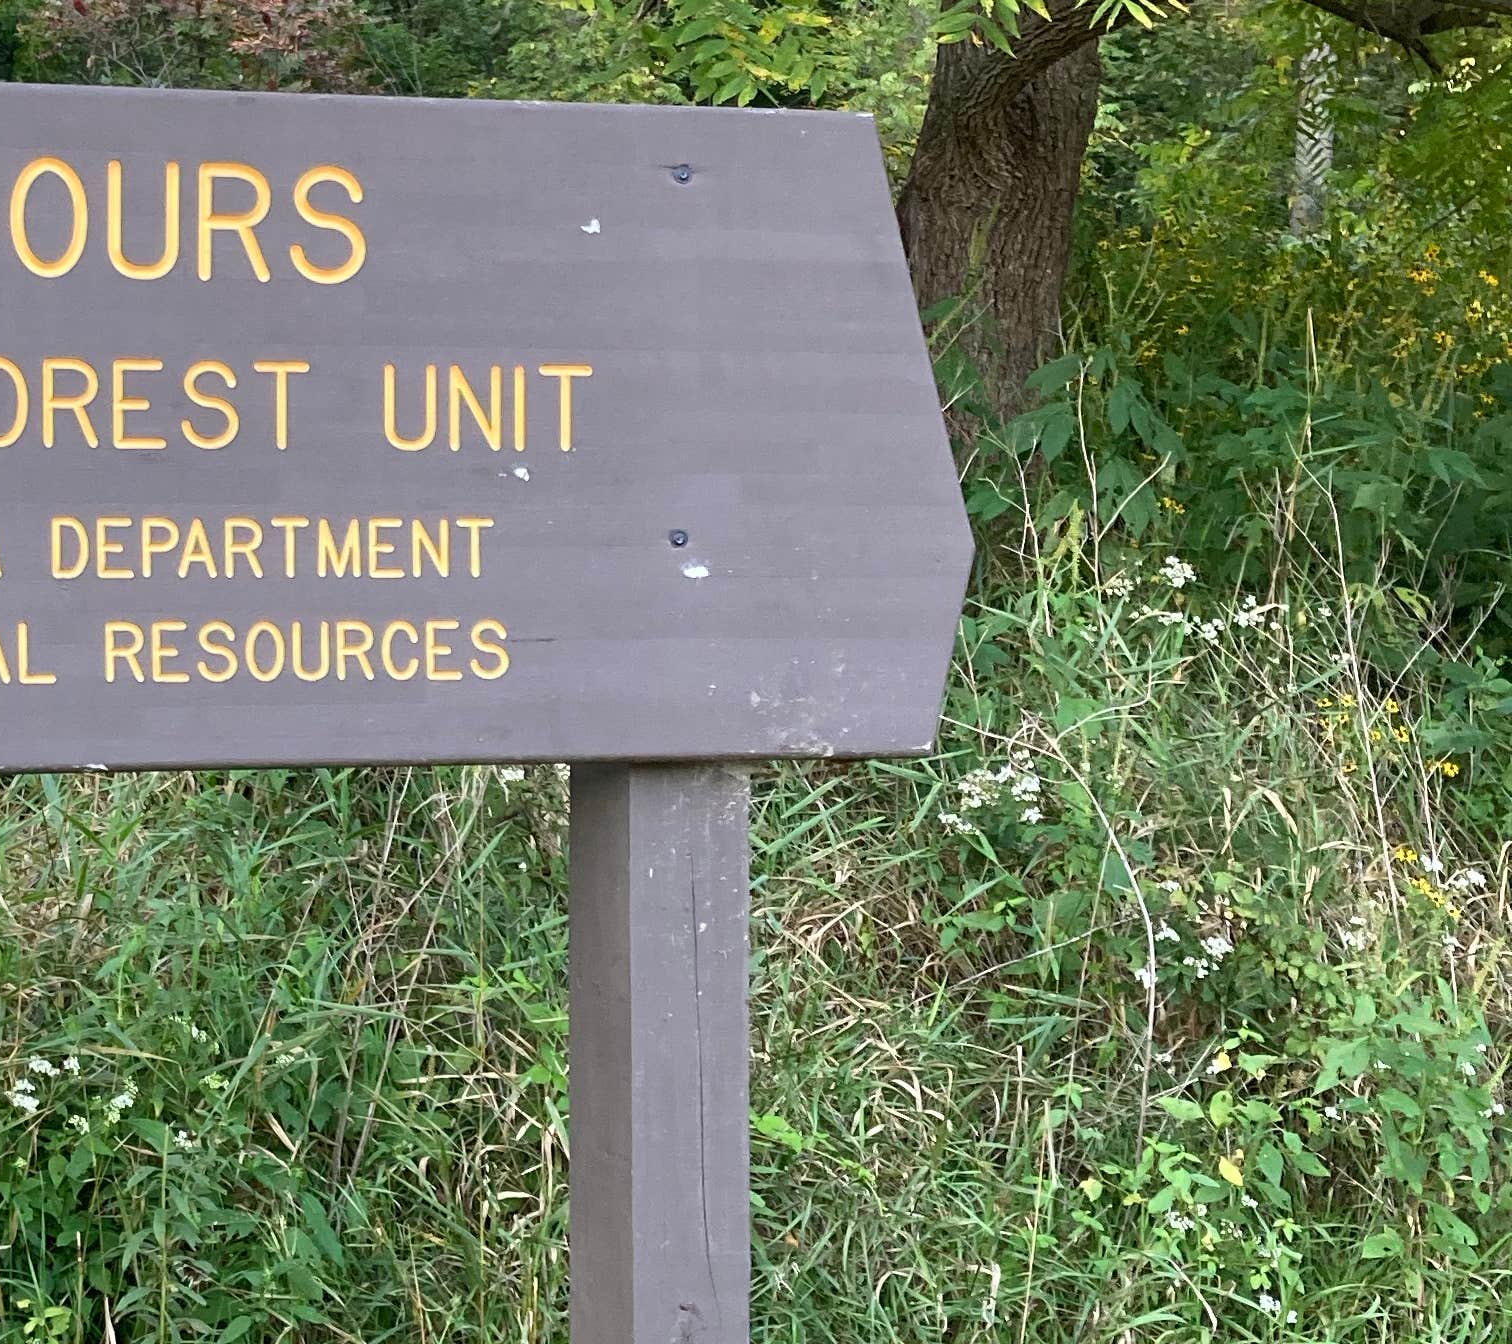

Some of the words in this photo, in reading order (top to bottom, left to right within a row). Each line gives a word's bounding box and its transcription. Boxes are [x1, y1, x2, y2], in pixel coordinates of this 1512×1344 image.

[384, 363, 593, 451] UNIT
[51, 515, 493, 578] DEPARTMENT
[105, 618, 509, 682] RESOURCES
